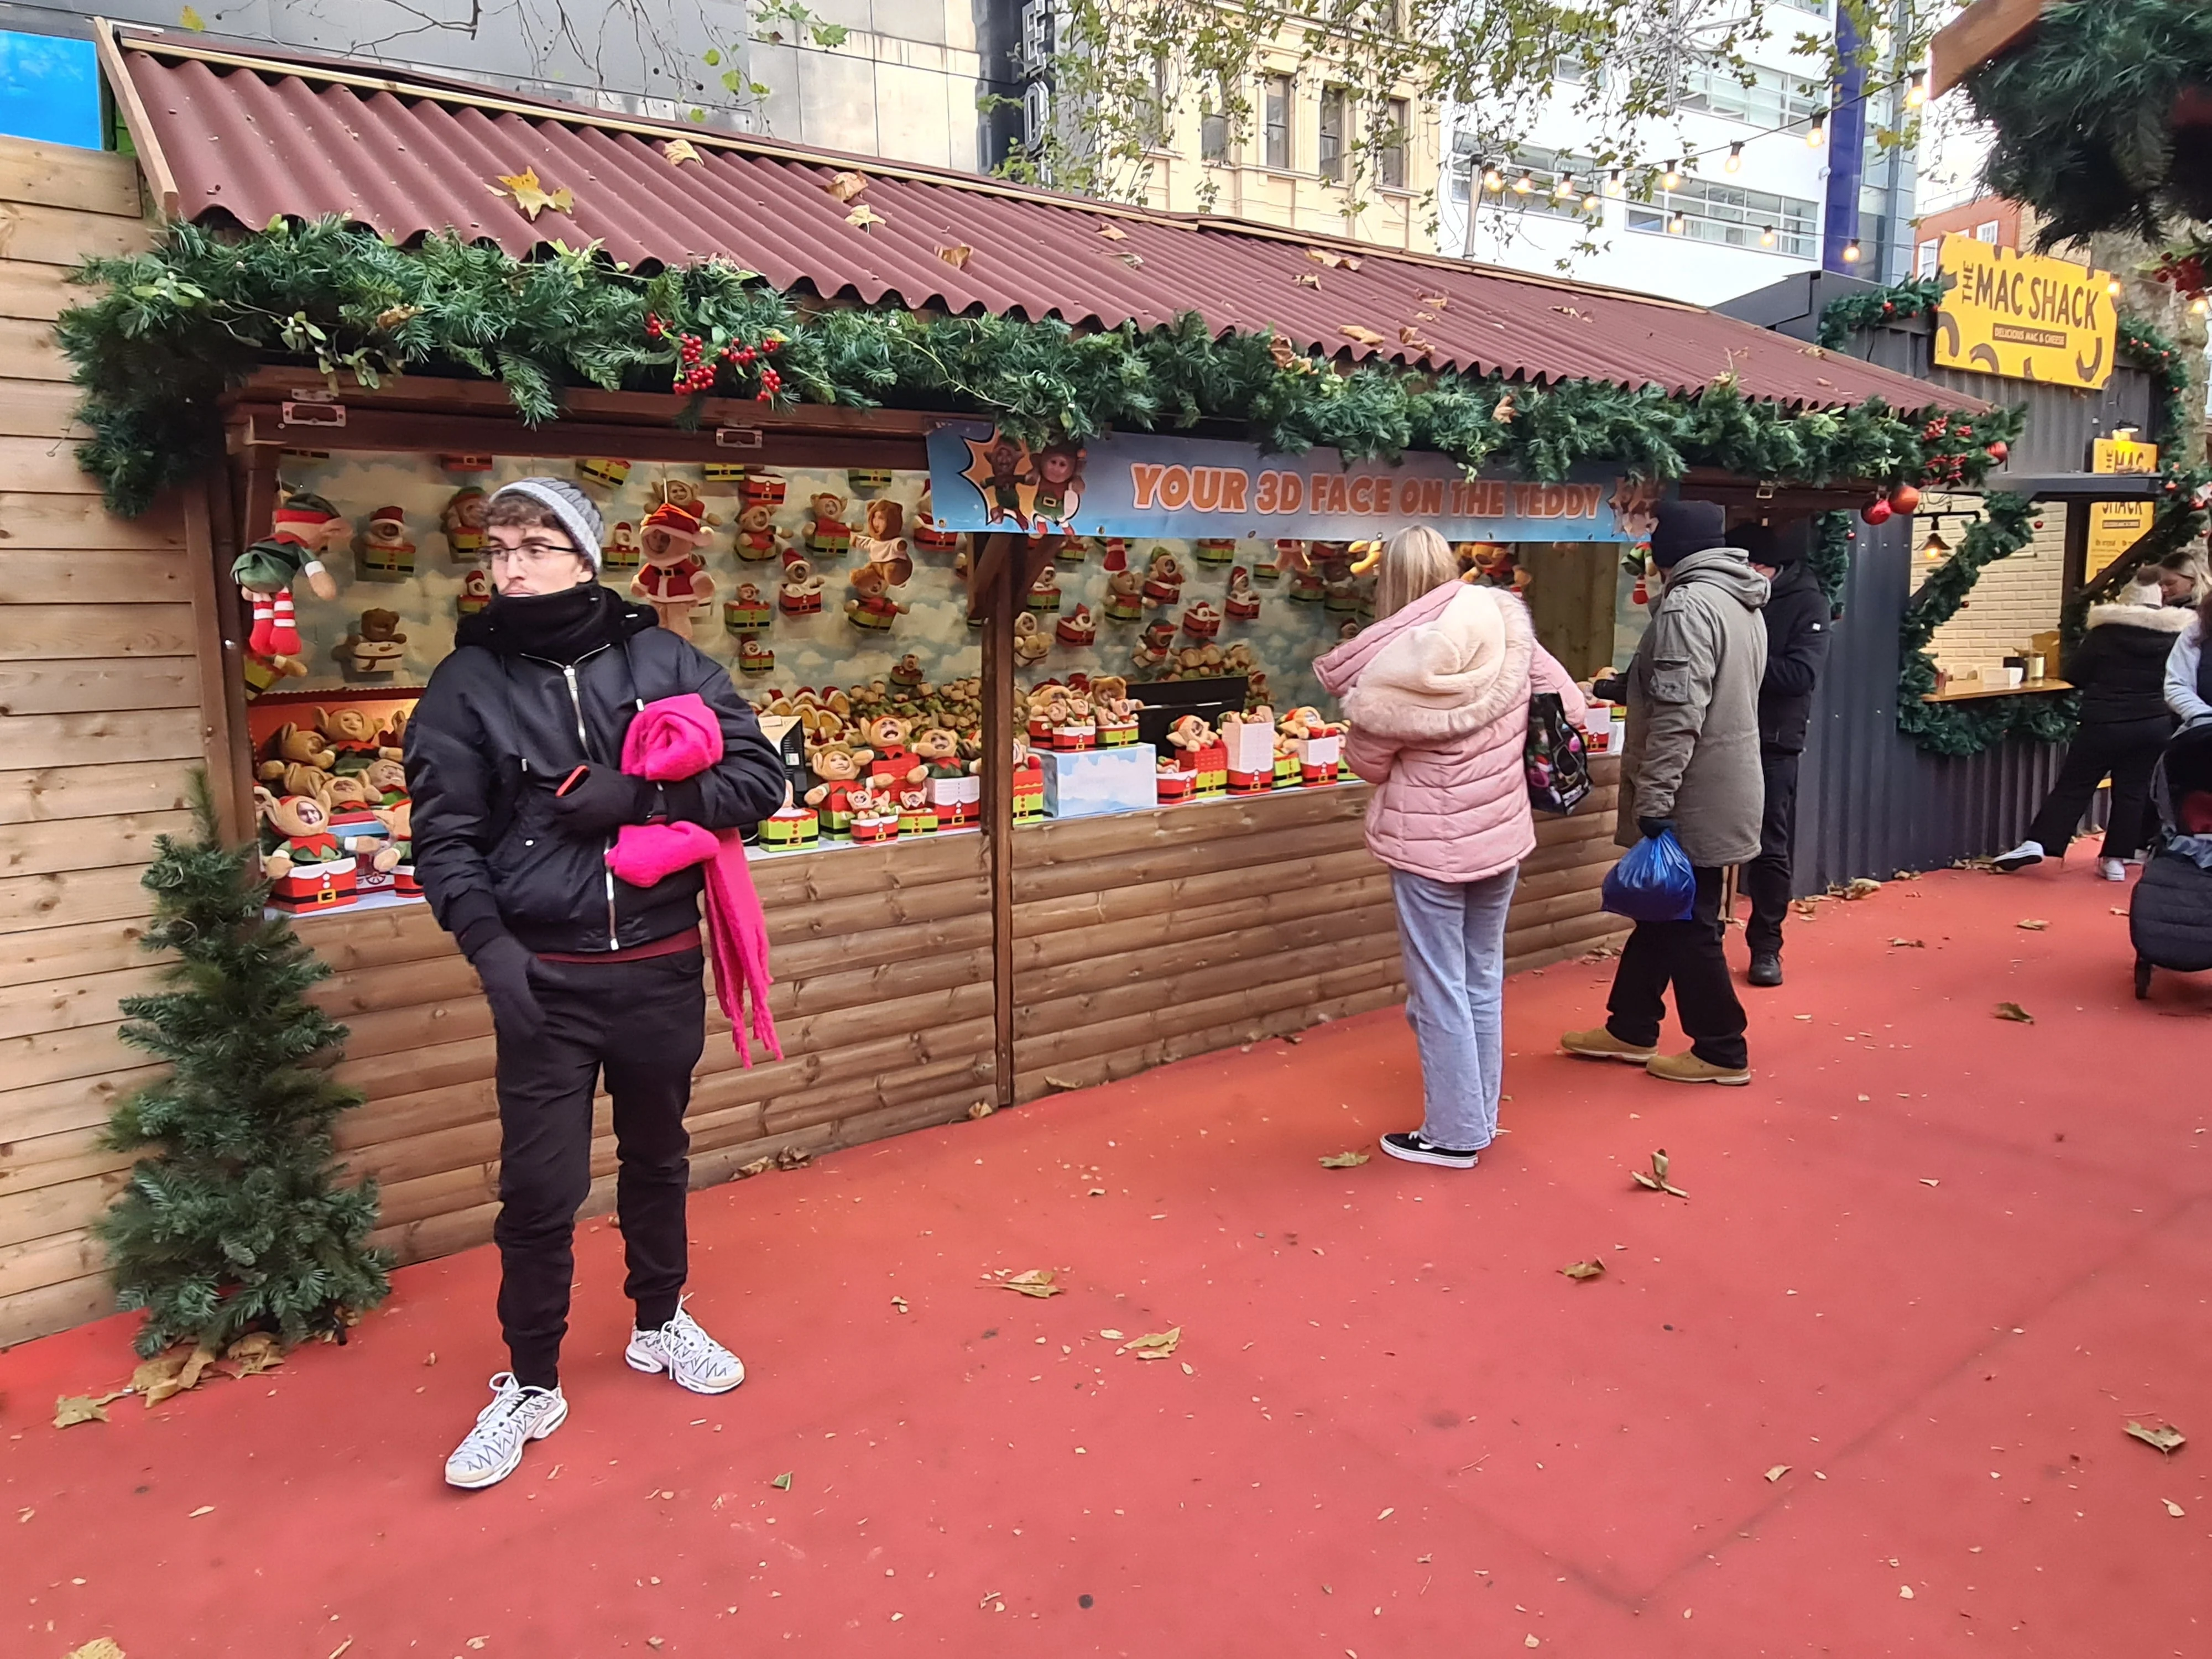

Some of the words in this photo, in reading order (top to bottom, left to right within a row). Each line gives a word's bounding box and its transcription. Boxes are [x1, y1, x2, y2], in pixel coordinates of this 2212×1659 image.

[1962, 260, 1974, 304] THE
[1975, 263, 2024, 316] MAC
[2028, 276, 2099, 330] SHACK
[1994, 327, 2024, 341] DELICIOUS
[2025, 332, 2038, 342] MAC
[1130, 463, 1248, 512] YOUR
[1255, 469, 1304, 515] 3D
[1310, 472, 1392, 516] FACE
[1399, 477, 1442, 517] ON
[1449, 478, 1507, 518] THE
[1511, 482, 1601, 519] TEDDY
